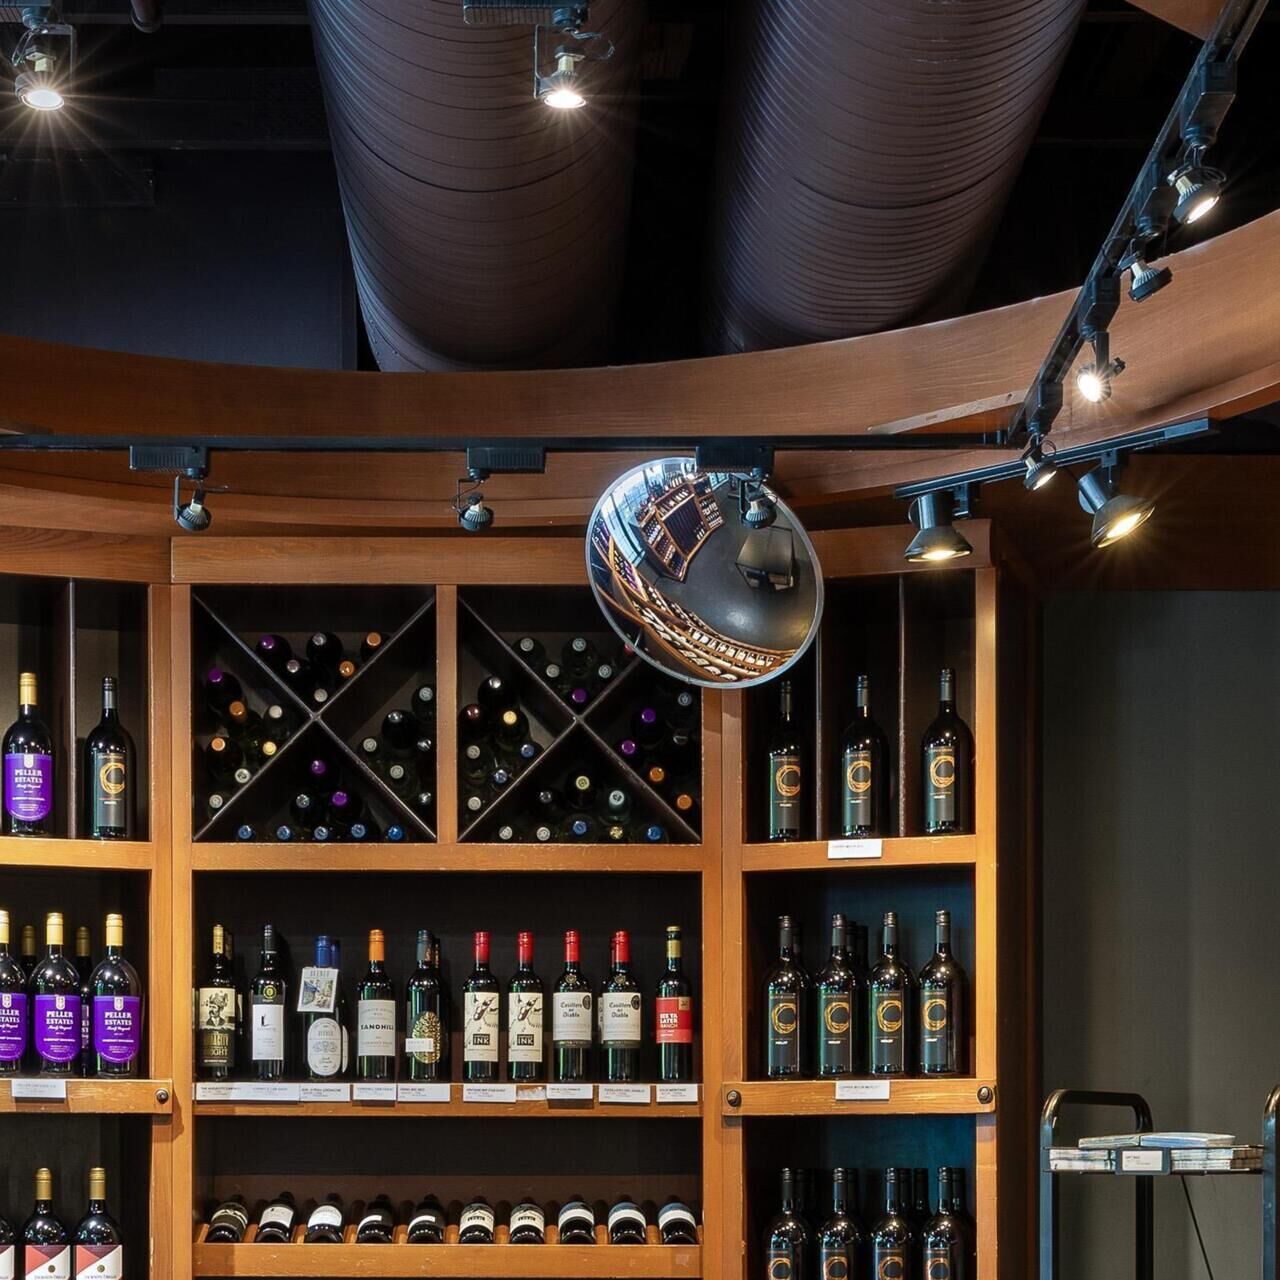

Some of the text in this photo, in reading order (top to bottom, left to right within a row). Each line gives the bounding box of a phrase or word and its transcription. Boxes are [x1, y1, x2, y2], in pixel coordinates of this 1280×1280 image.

[46, 1010, 74, 1018] PELLER
[104, 1011, 132, 1019] PELLER
[473, 1036, 490, 1046] INK
[517, 1036, 534, 1046] INK
